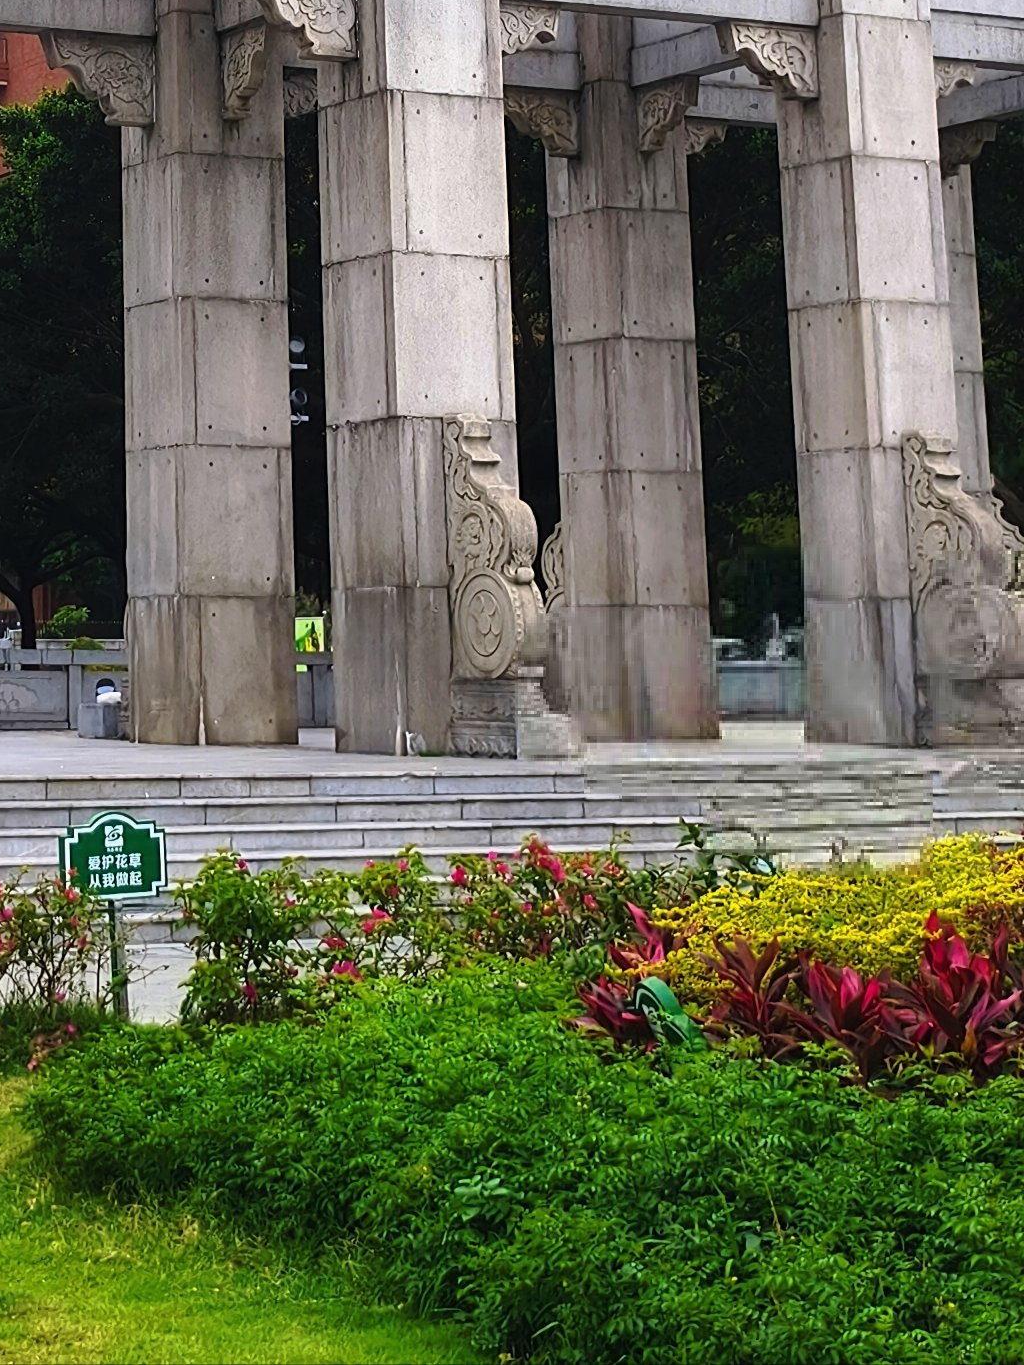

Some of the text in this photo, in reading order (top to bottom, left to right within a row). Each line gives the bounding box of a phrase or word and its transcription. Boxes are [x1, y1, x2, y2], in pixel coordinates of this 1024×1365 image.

[88, 852, 142, 870] 爱护花草
[89, 871, 142, 888] 从我做起
